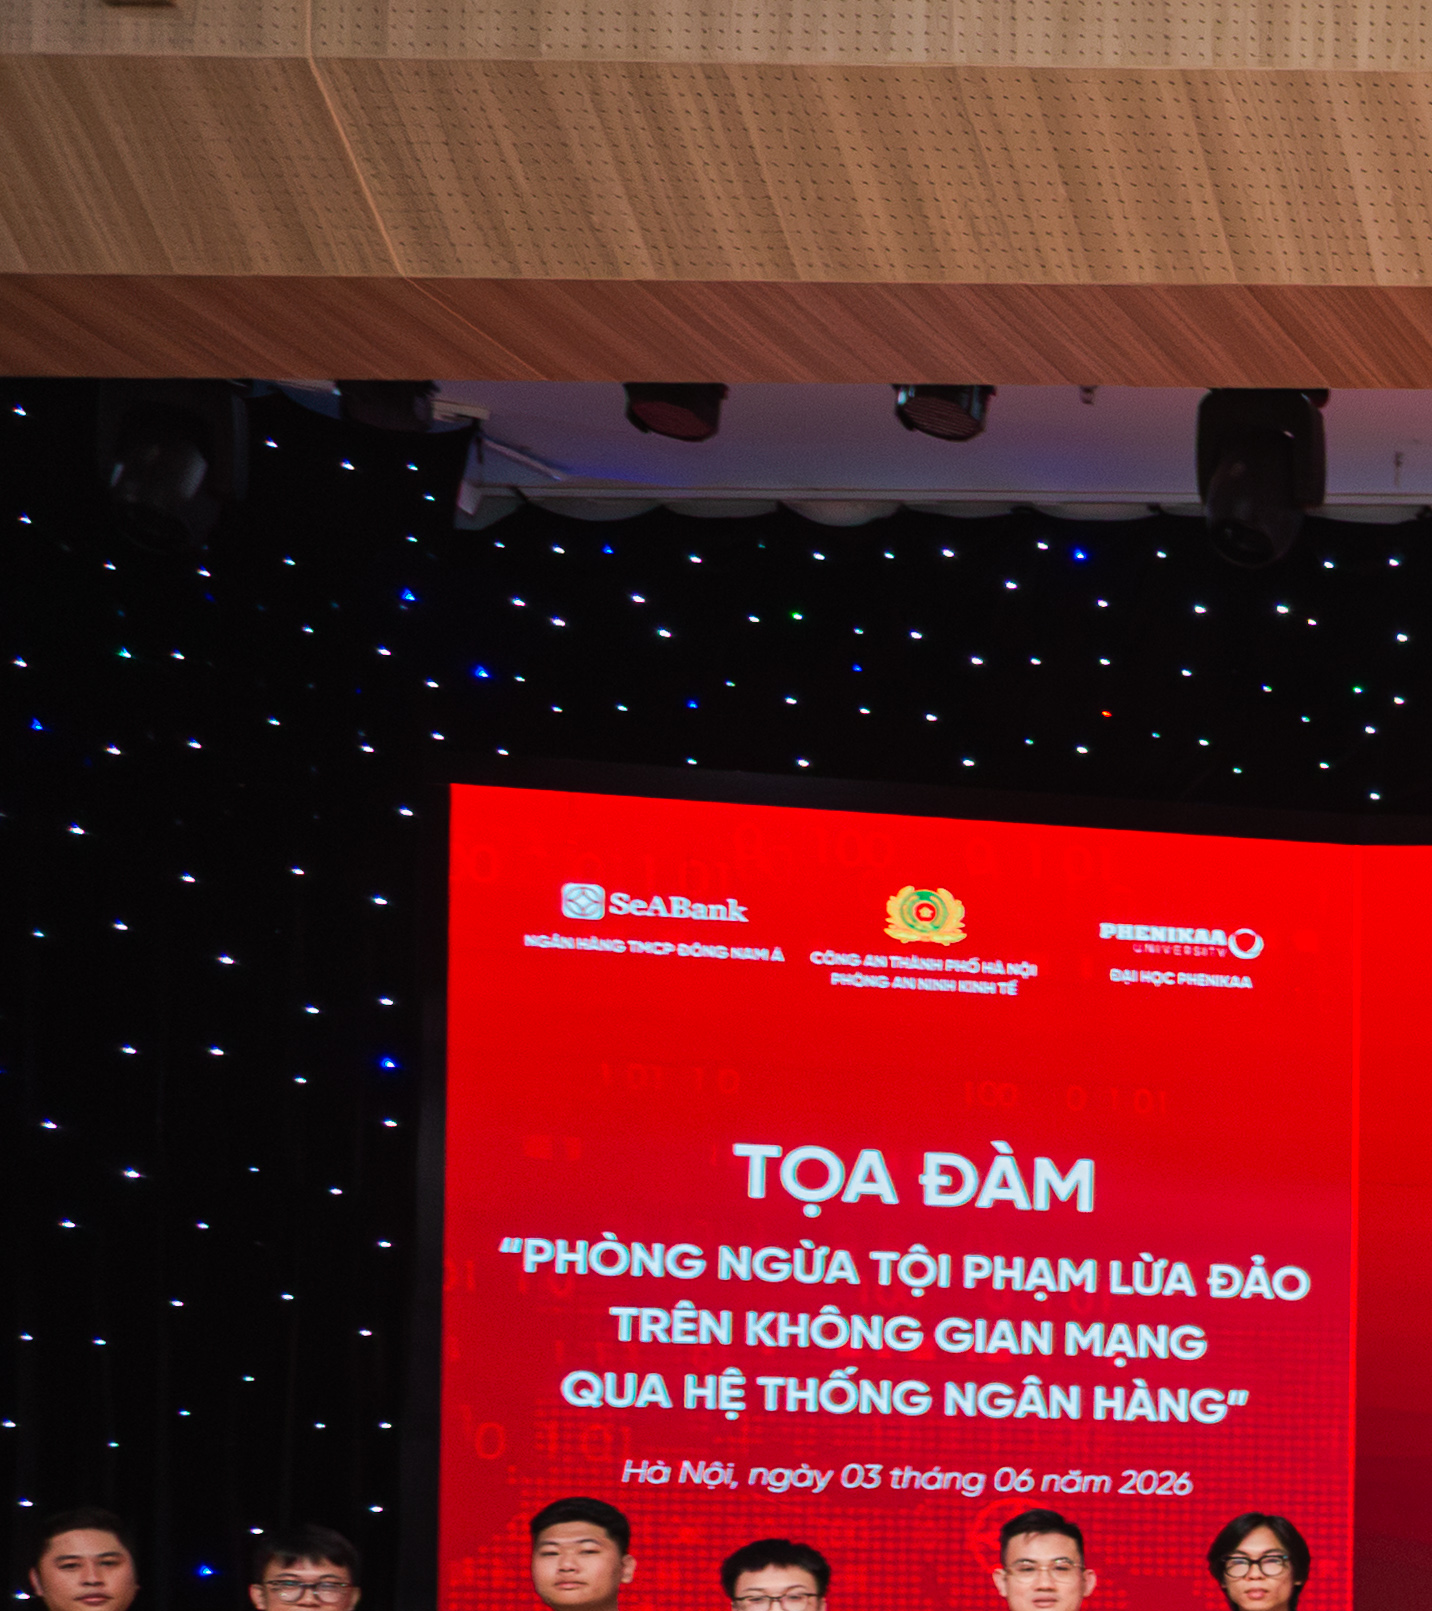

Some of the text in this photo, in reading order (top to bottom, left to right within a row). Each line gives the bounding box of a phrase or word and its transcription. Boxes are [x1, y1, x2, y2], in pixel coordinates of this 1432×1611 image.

[609, 893, 748, 922] SeABank
[524, 934, 785, 961] NGÂN HÀNG TMCP ĐÔNG NAM Á
[1100, 923, 1227, 945] PHENIKAA
[810, 950, 1037, 978] CÔNG AN THÀNH PHỐ HÀ NỘI
[1133, 943, 1226, 957] UNIVERSITY
[831, 972, 1017, 995] PHÒNG AN NINH KINH TẾ
[1110, 969, 1252, 988] ĐẠI HỌC PHENIKAA
[733, 1141, 1094, 1217] TỌA ĐÀM
[500, 1232, 1310, 1301] “PHÒNG NGỪA TỘI PHẠM LỪA ĐẢO
[609, 1300, 1207, 1367] TRÊN KHÔNG GIAN MẠNG
[561, 1366, 1249, 1423] QUA HỆ THỐNG NGÂN HÀNG”
[622, 1460, 1192, 1497] Hà Nội, ngày 03 tháng 06 năm 2026
